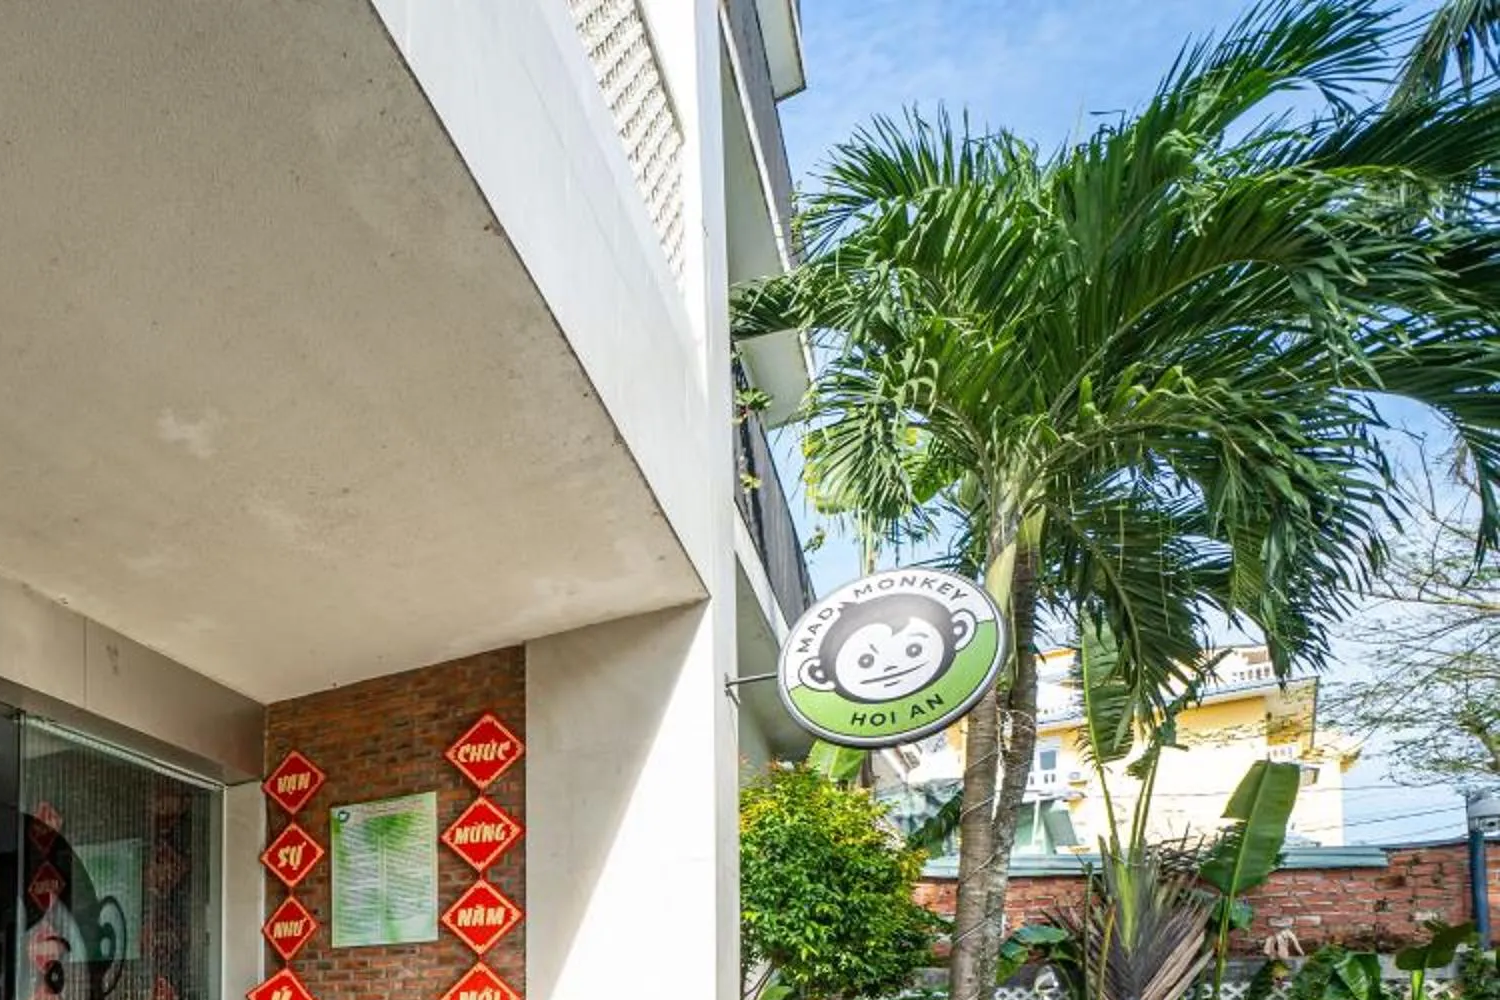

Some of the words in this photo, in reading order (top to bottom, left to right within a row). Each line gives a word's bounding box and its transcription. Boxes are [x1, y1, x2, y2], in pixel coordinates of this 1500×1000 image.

[796, 606, 837, 653] MAD
[852, 575, 969, 600] MONKEY
[850, 710, 896, 728] HOI
[909, 693, 945, 720] AN
